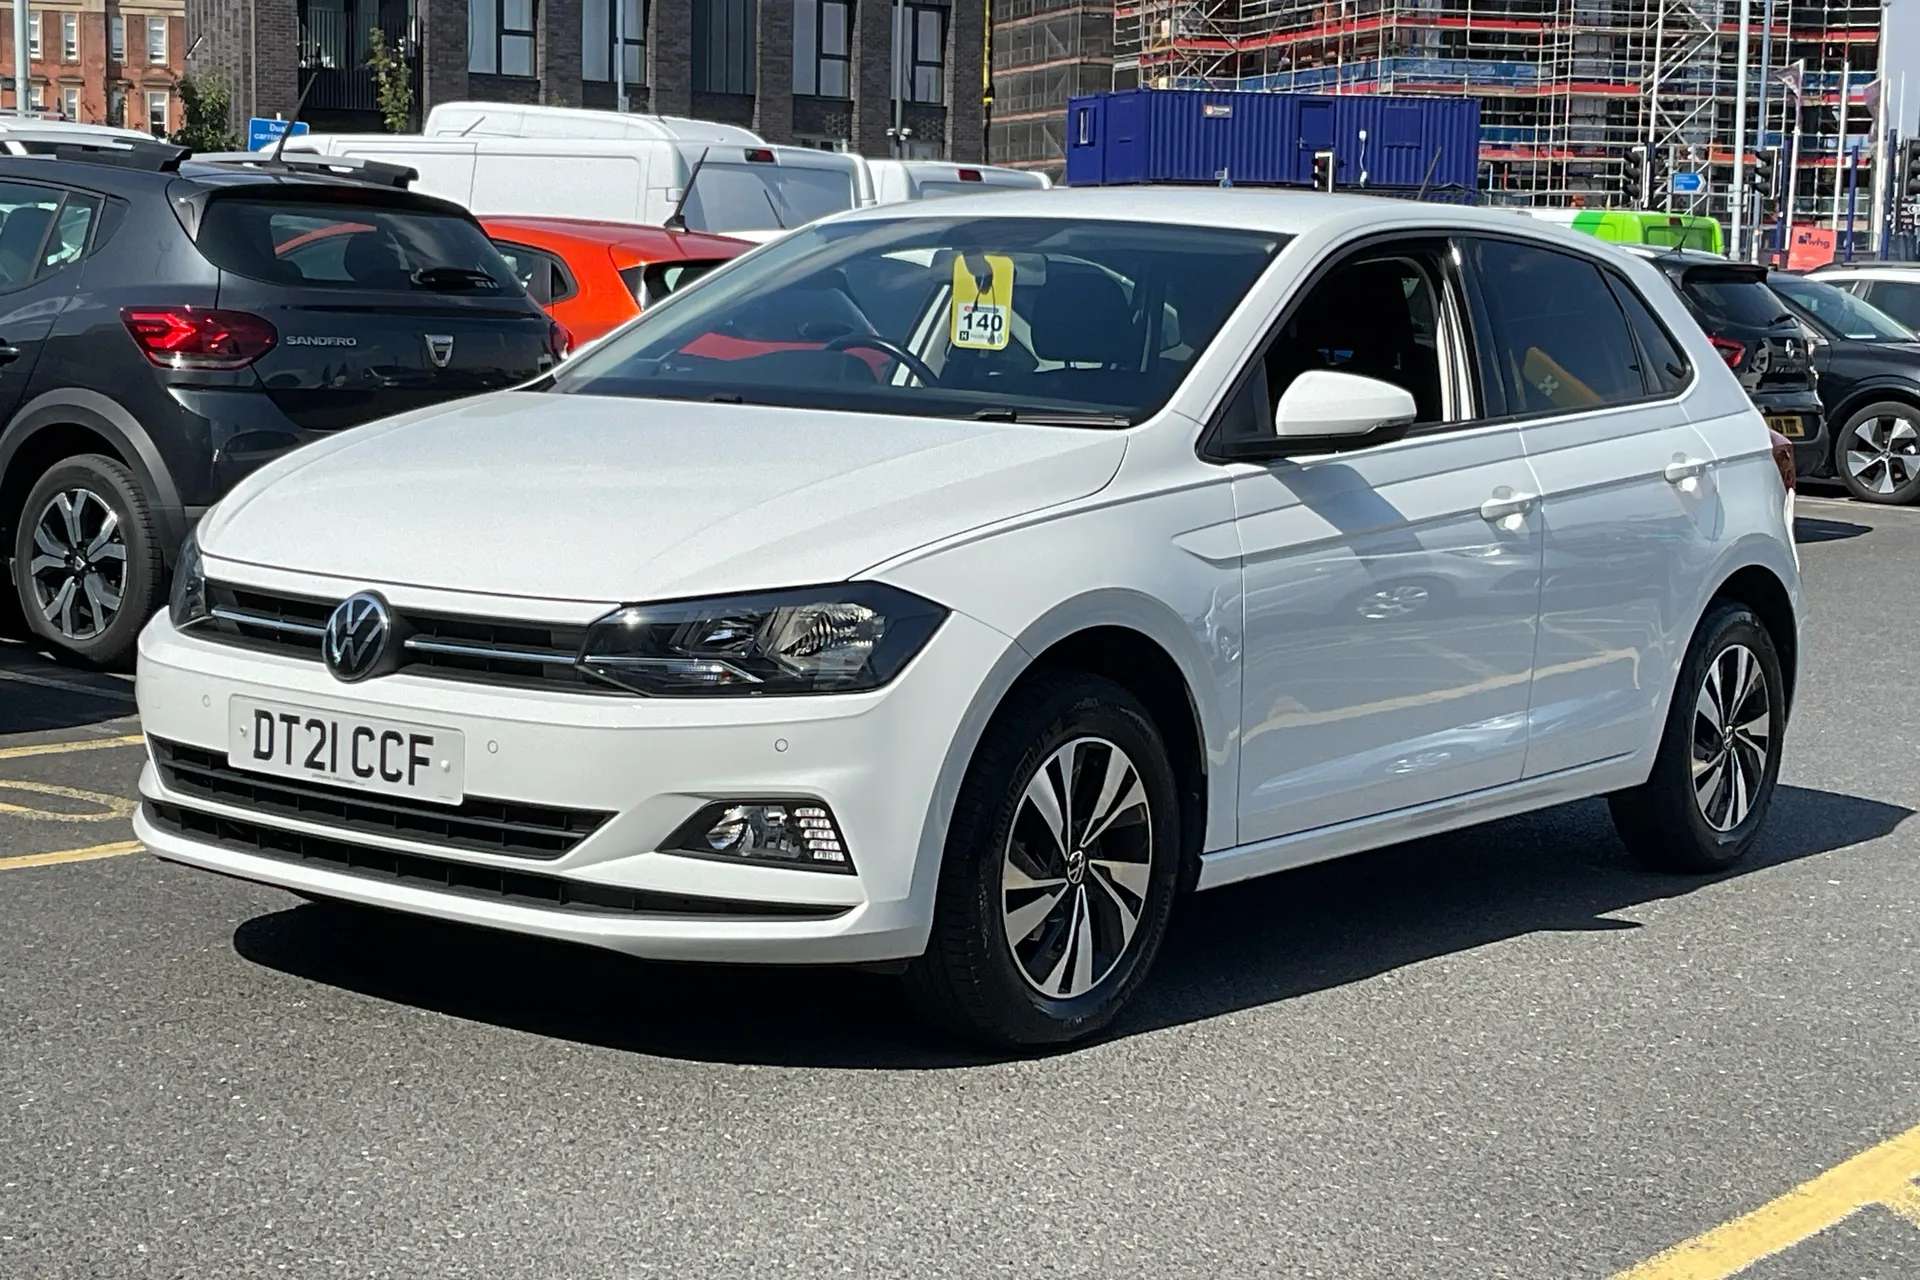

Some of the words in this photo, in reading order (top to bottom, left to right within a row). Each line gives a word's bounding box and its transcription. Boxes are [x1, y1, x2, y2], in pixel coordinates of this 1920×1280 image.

[963, 313, 1003, 332] 140
[286, 336, 357, 346] SANDERO
[253, 709, 338, 773] DT21
[352, 726, 434, 786] CCF
